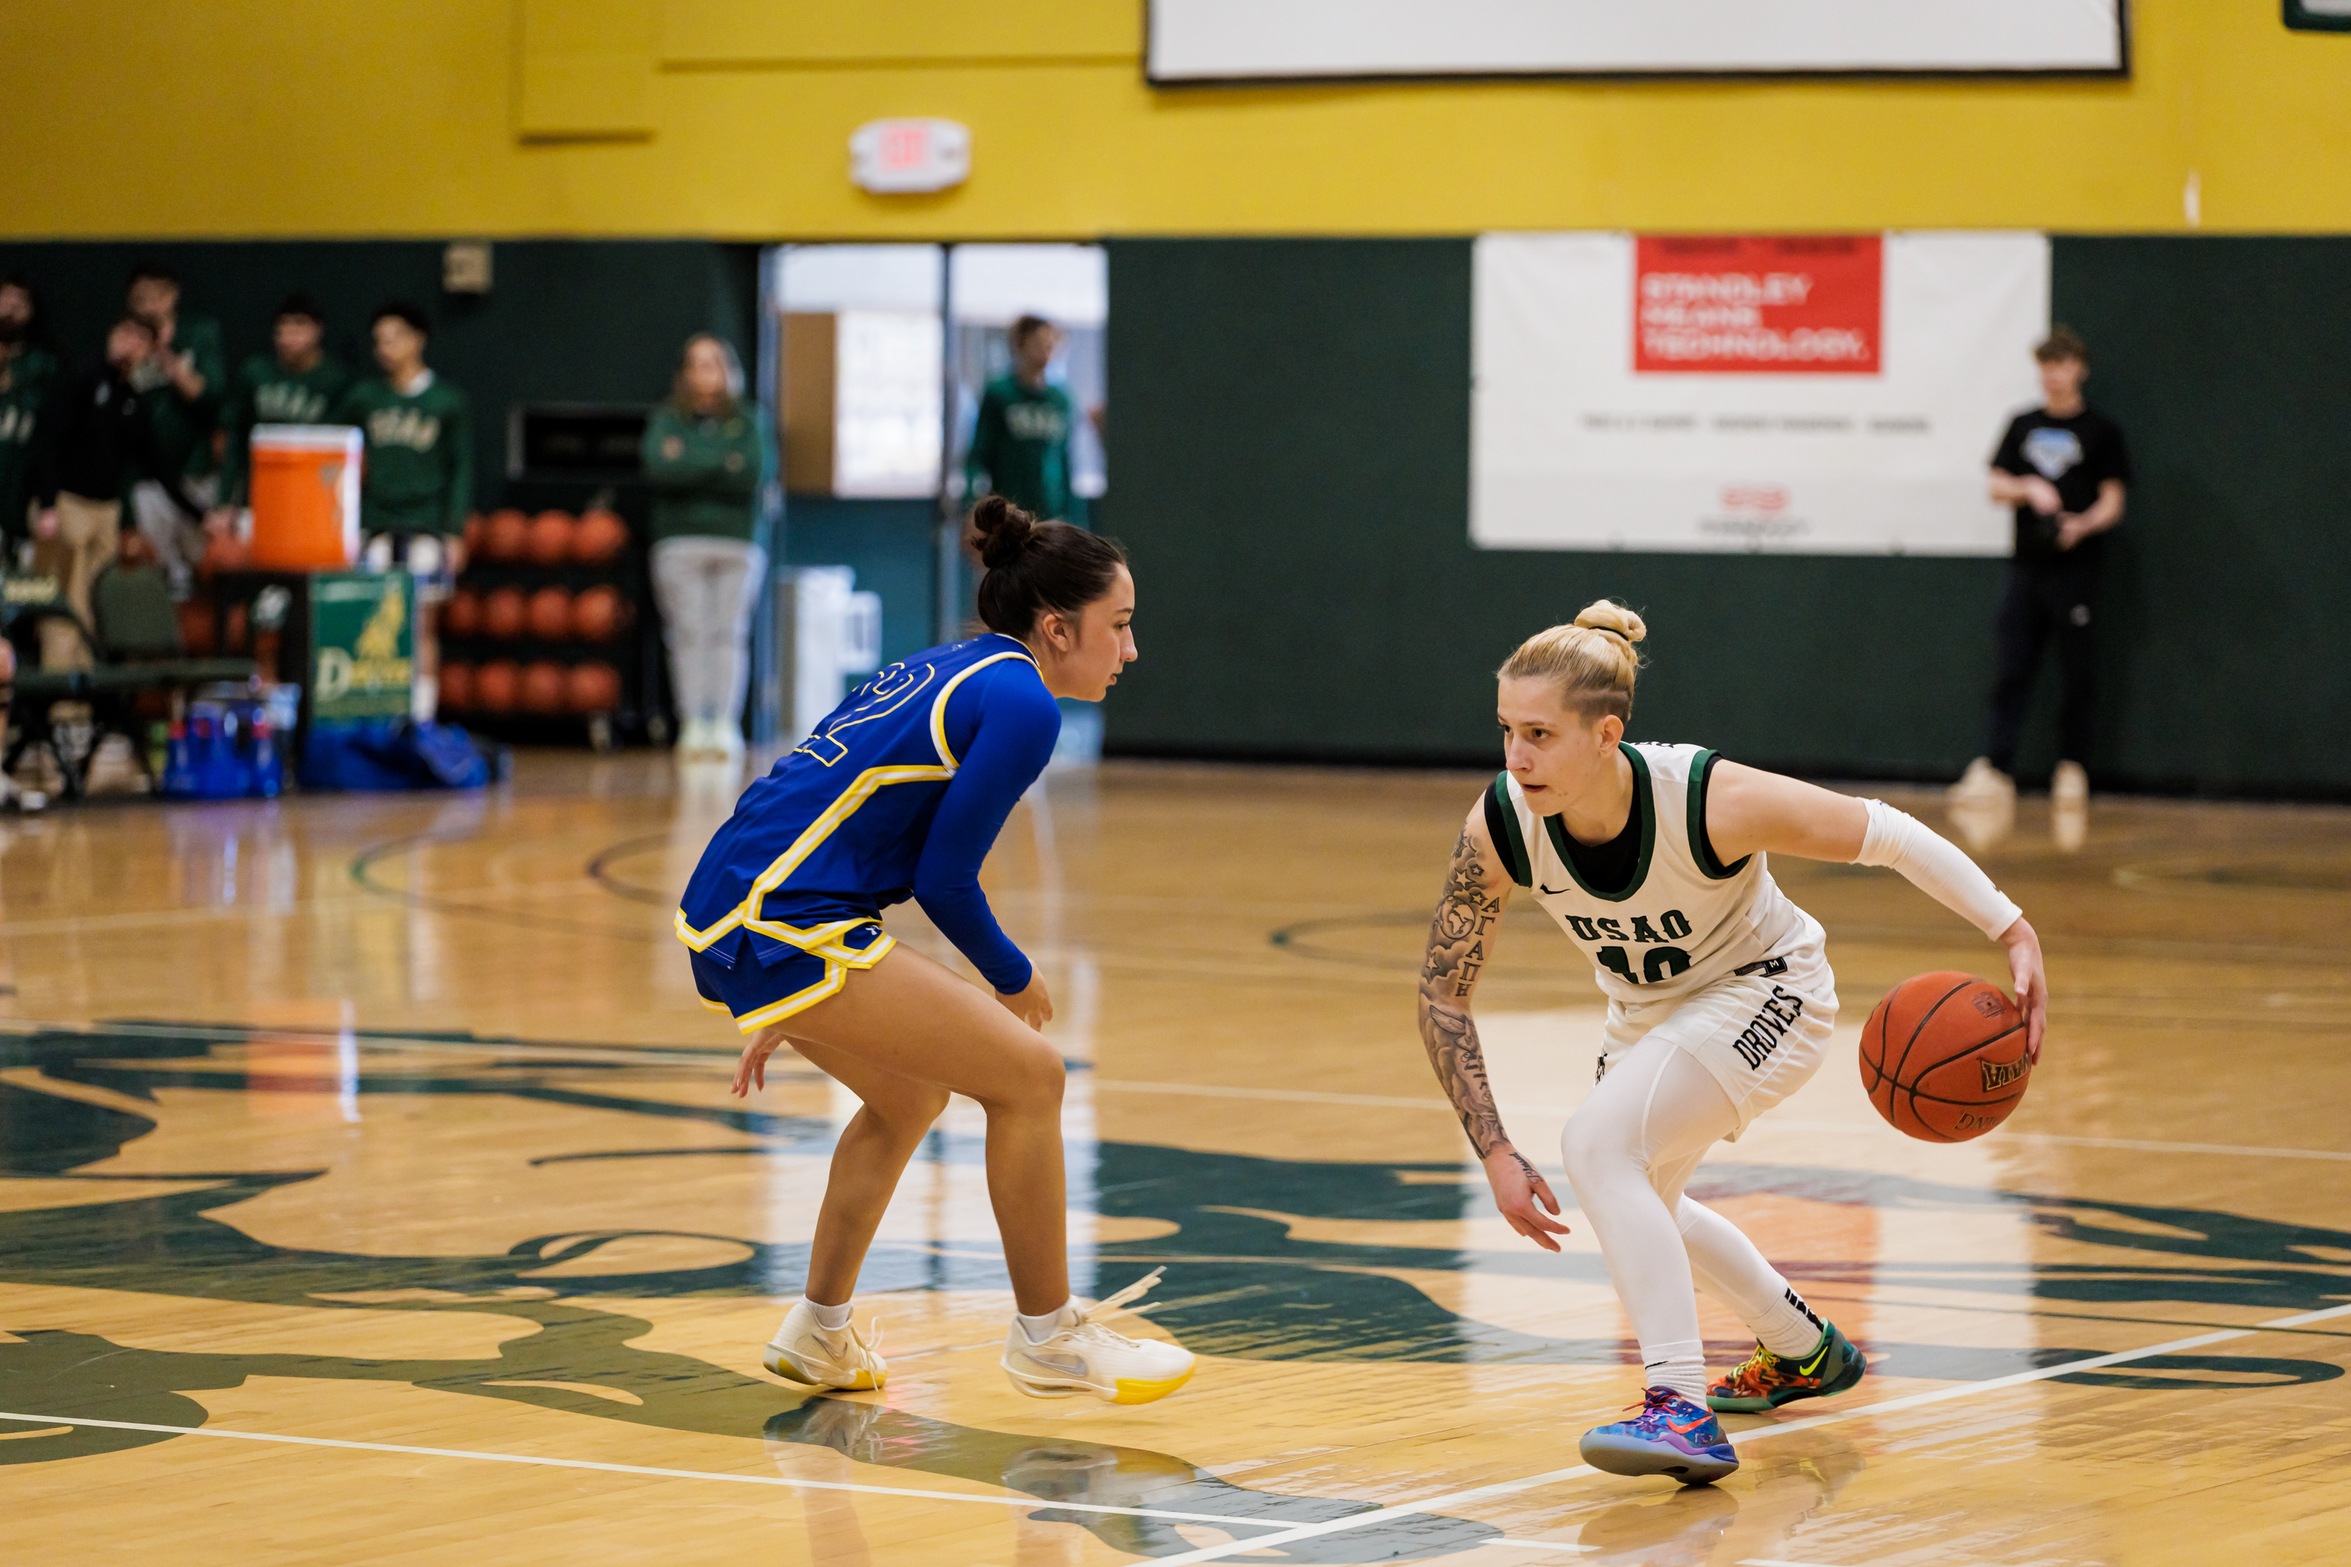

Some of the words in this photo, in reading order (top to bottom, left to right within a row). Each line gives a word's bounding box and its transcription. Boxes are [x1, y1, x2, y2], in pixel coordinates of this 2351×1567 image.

[1564, 909, 1692, 943] USAO
[1595, 946, 1692, 985] 10
[1769, 960, 1780, 969] M
[1732, 984, 1804, 1071] DROVES
